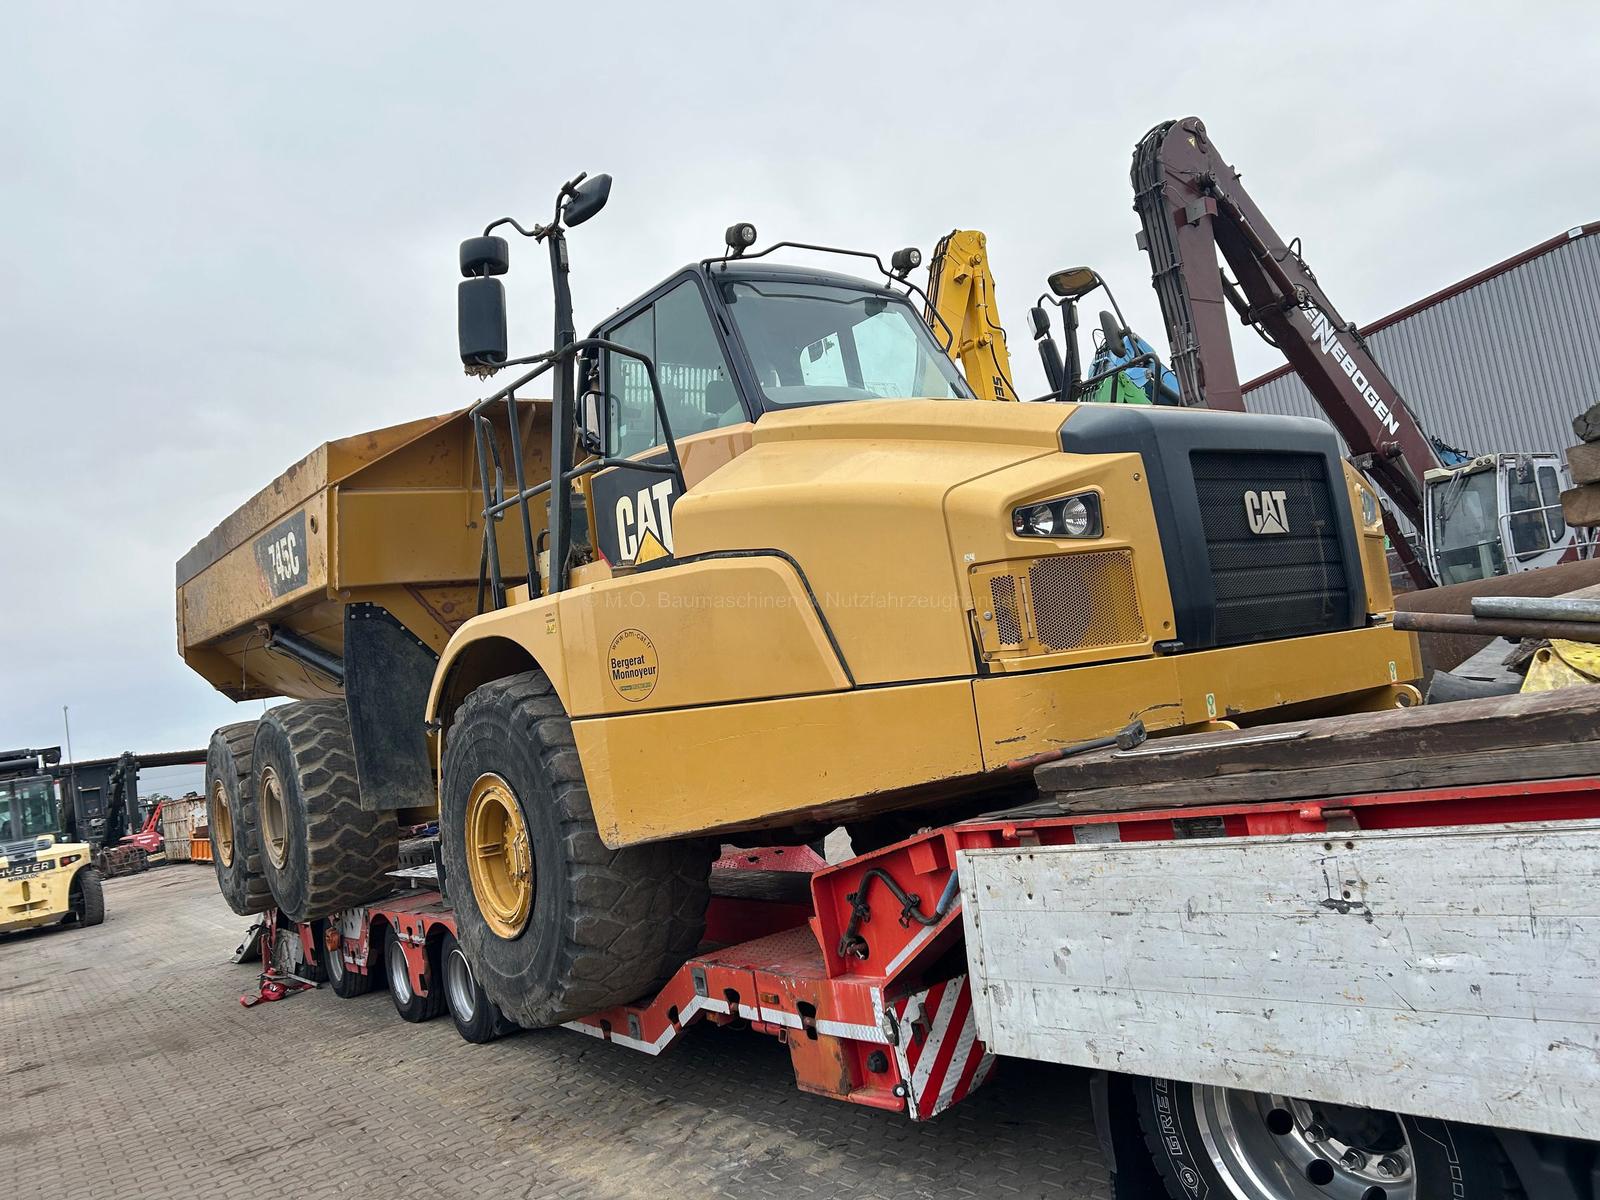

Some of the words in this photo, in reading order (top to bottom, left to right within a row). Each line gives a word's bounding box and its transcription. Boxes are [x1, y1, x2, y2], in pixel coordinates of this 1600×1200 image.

[992, 375, 1008, 401] SE
[615, 478, 674, 564] CAT
[1244, 490, 1290, 535] CAT
[267, 531, 300, 584] 745C
[610, 654, 645, 669] Bergerat
[612, 666, 656, 681] Monnoyeur
